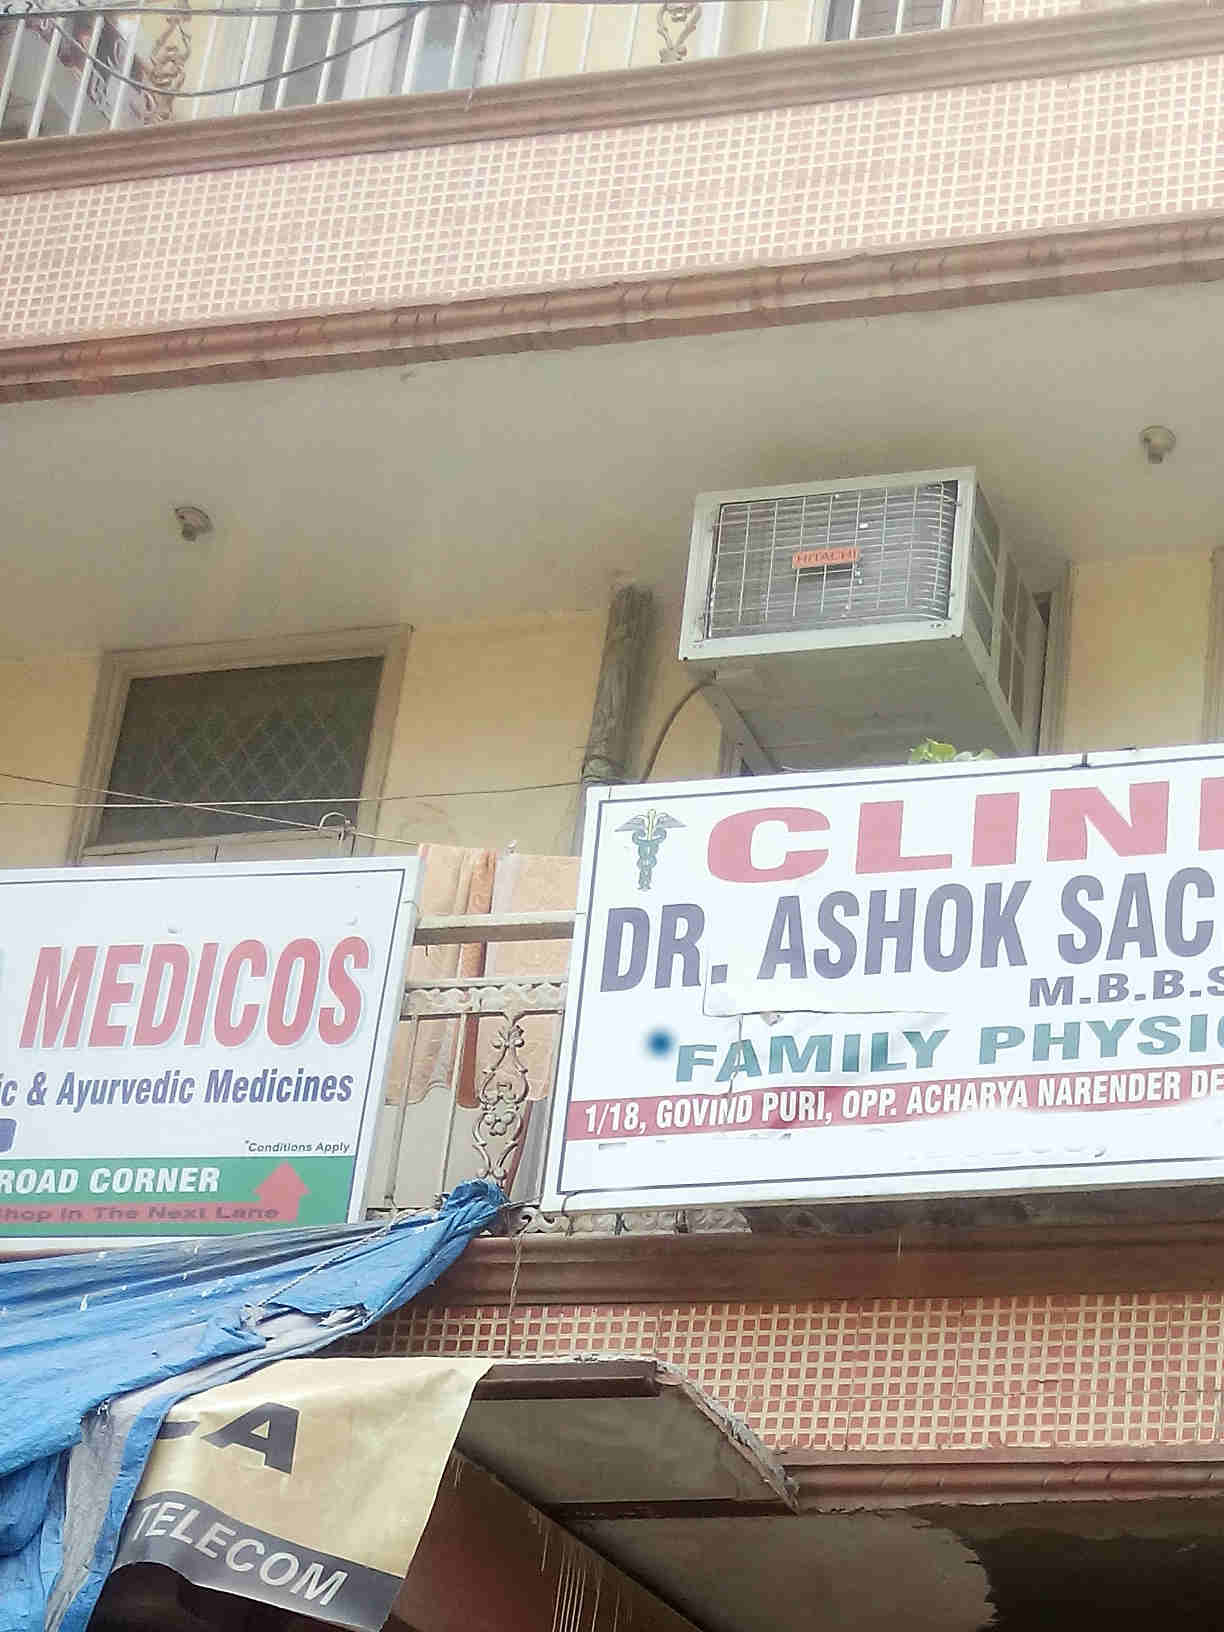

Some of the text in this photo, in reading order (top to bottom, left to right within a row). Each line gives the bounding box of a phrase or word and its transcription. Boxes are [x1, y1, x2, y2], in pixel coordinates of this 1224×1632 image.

[600, 903, 728, 992] DR.
[756, 880, 1032, 980] ASHOK
[19, 936, 370, 1049] MEDICOS
[675, 1029, 950, 1083] FAMILY
[27, 1072, 48, 1106] &
[56, 1070, 195, 1113] Ayurvedic
[204, 1068, 354, 1103] Medicines
[585, 1102, 647, 1137] 1/18,
[656, 1094, 753, 1129] GOVIND
[761, 1090, 833, 1126] PURI,
[842, 1087, 897, 1120] OPP.
[906, 1078, 1027, 1115] ACHARYA
[1038, 1072, 1181, 1107] NARENDER
[315, 1142, 350, 1154] Apply
[0, 1167, 220, 1194] ROAD CORNER
[0, 1207, 51, 1221] hop
[96, 1206, 139, 1219] The
[148, 1205, 208, 1219] Next
[215, 1206, 280, 1219] Lane
[132, 1501, 348, 1606] TELECOM
